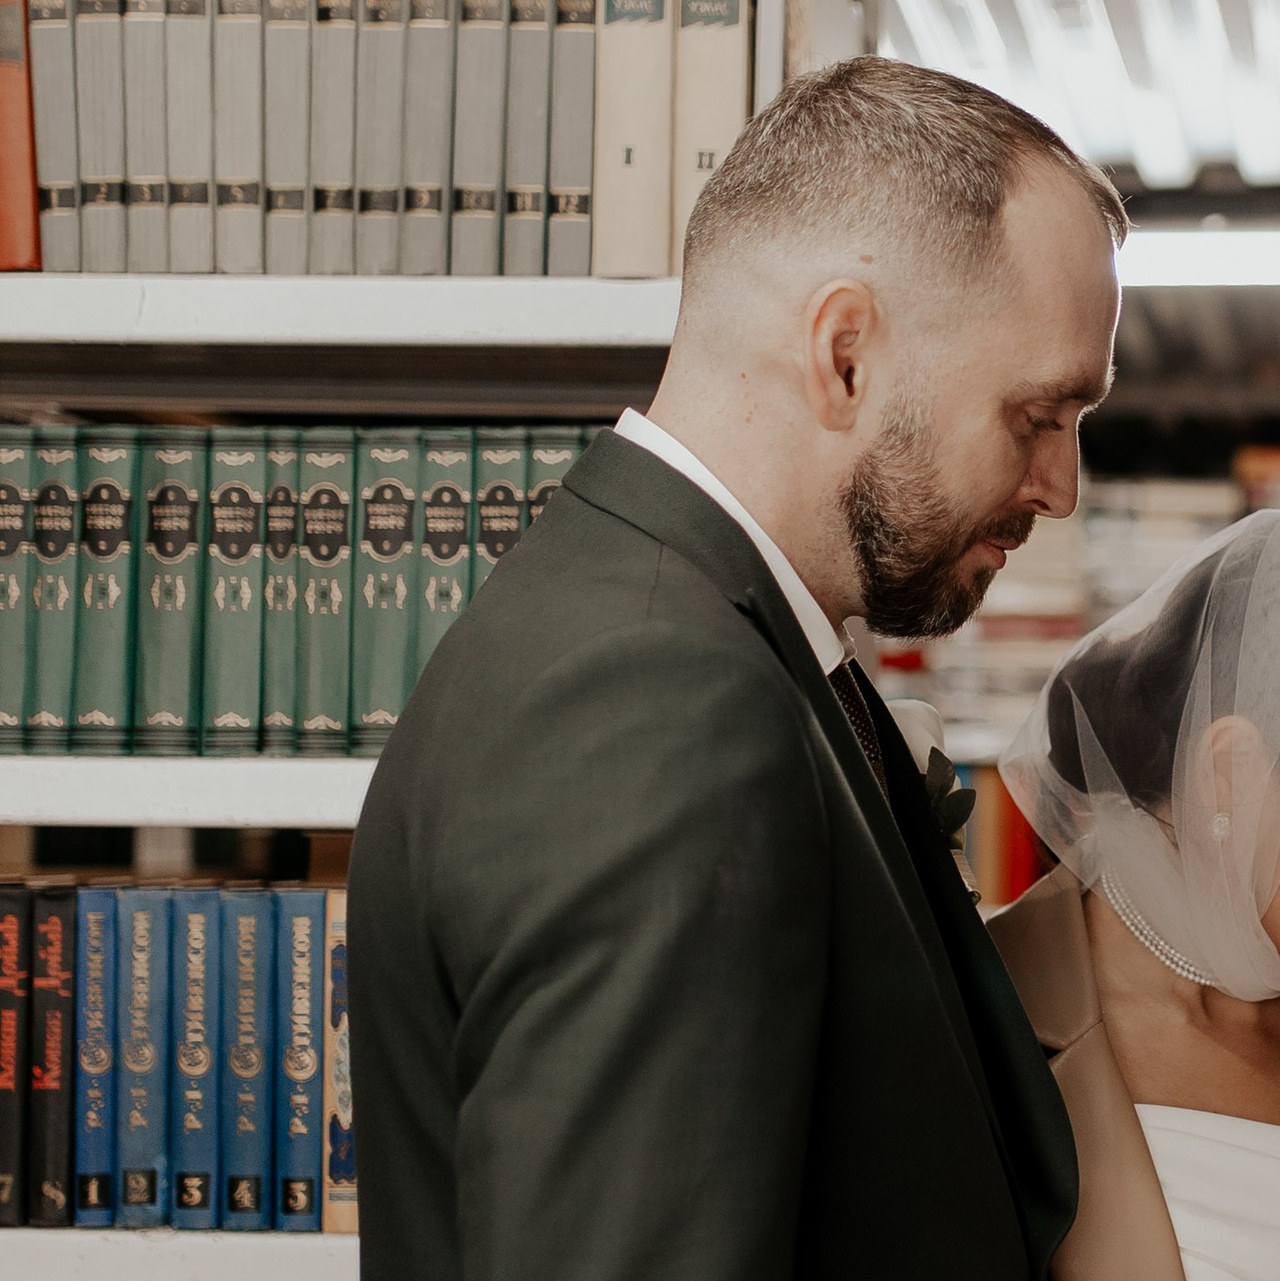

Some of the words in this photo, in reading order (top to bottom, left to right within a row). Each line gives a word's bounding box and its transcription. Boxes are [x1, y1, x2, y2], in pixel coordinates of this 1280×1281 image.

[623, 147, 634, 166] I
[697, 151, 715, 169] II
[81, 1178, 99, 1205] 1
[182, 1177, 204, 1206] 3
[287, 1184, 309, 1209] 5
